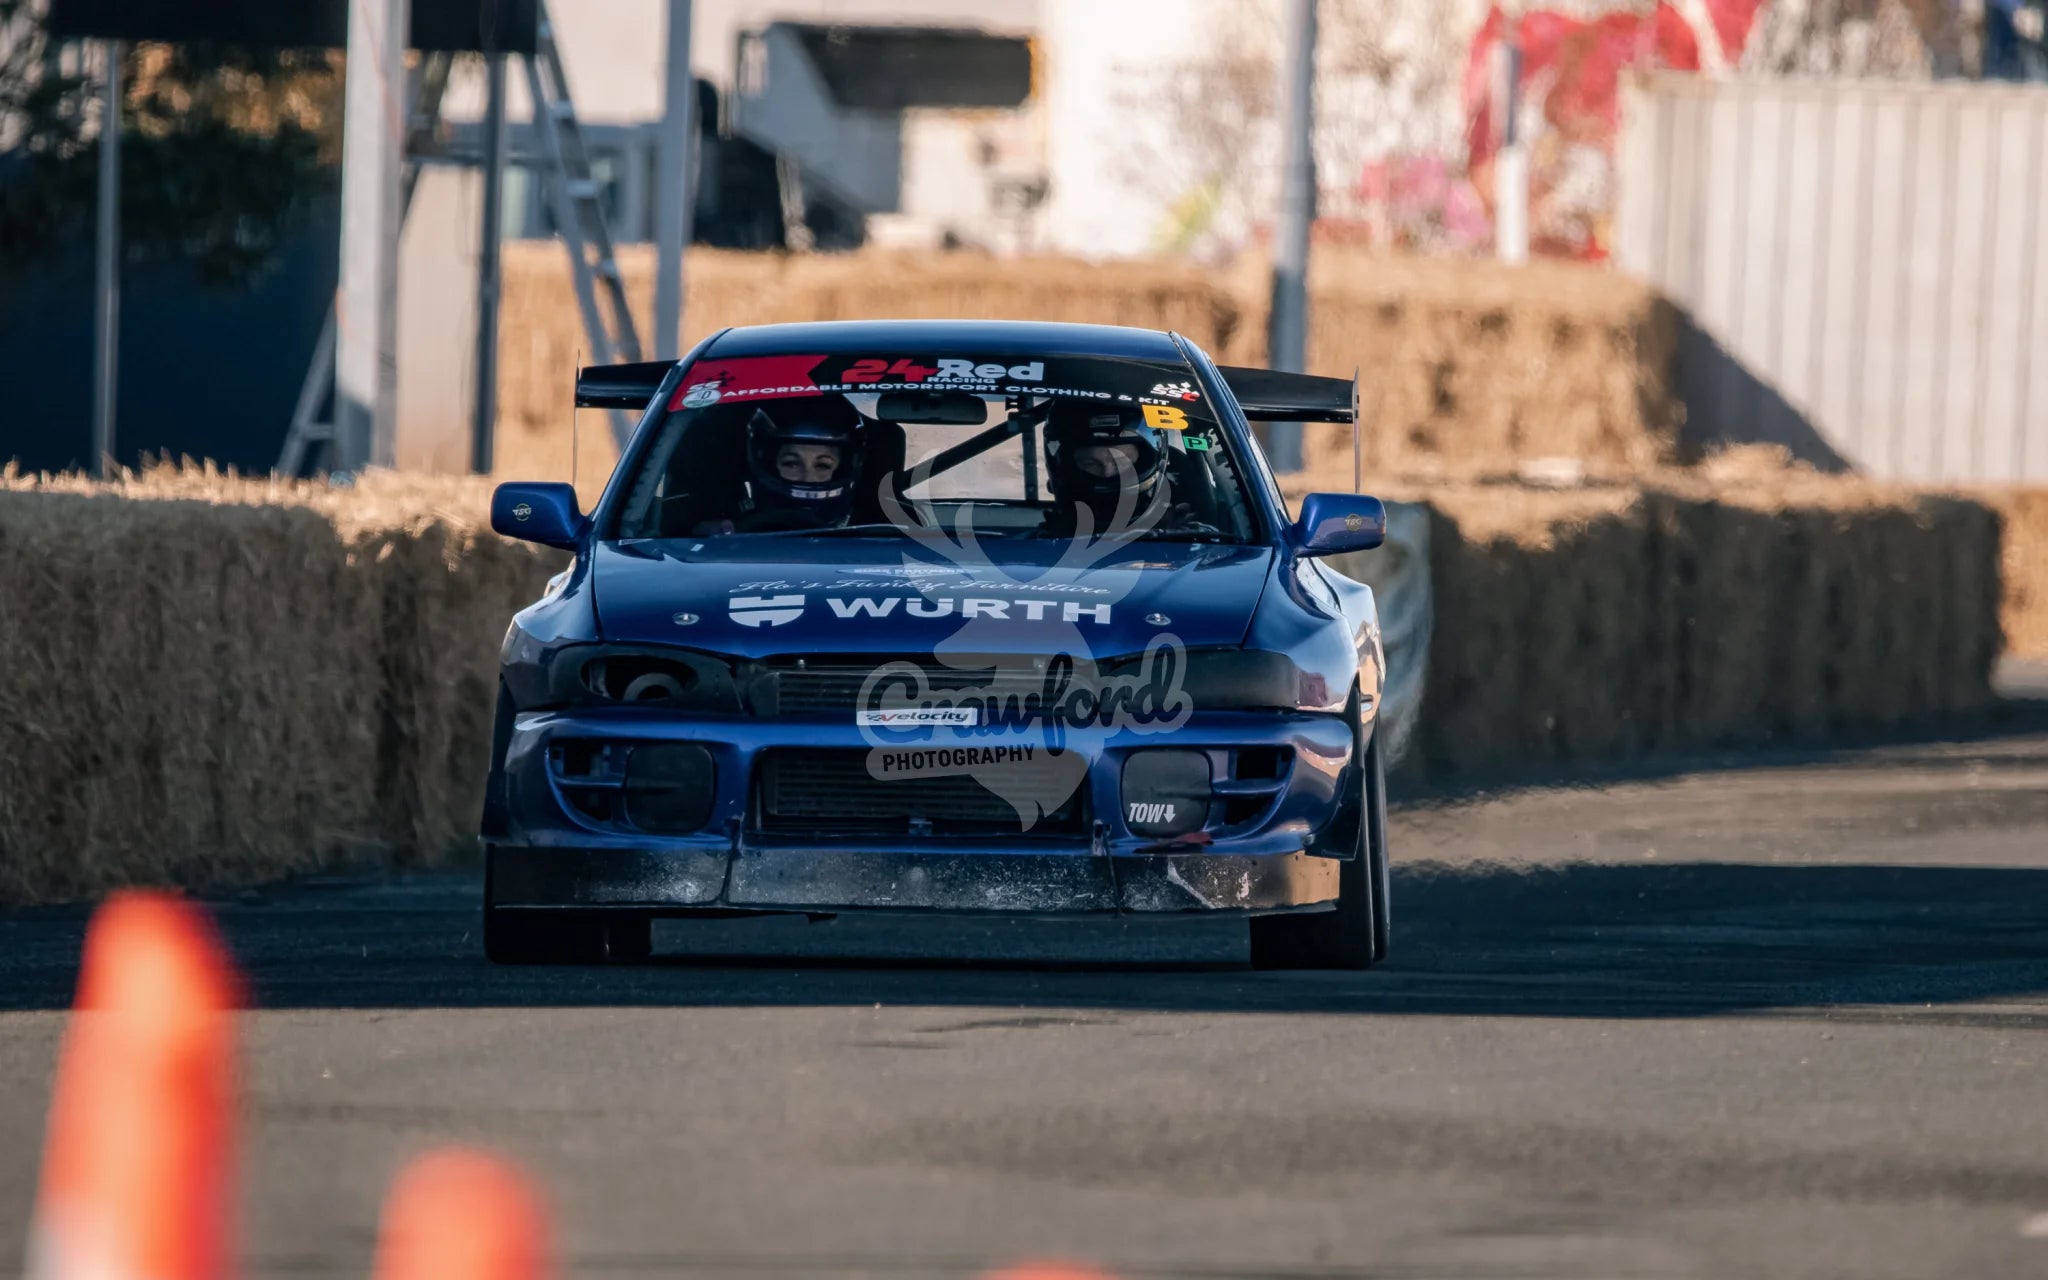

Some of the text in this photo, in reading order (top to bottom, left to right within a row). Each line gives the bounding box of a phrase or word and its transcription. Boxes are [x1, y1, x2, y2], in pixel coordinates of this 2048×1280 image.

[926, 376, 996, 384] RACING
[722, 383, 852, 397] AFFORDABLE
[858, 383, 999, 391] MOTORSPORT
[1005, 386, 1112, 399] CLOTHING
[1138, 396, 1170, 406] KIT
[1141, 404, 1190, 431] B
[1187, 437, 1203, 449] P
[728, 579, 1112, 594] Flo's Funky Furniture
[1128, 802, 1166, 823] TOW
